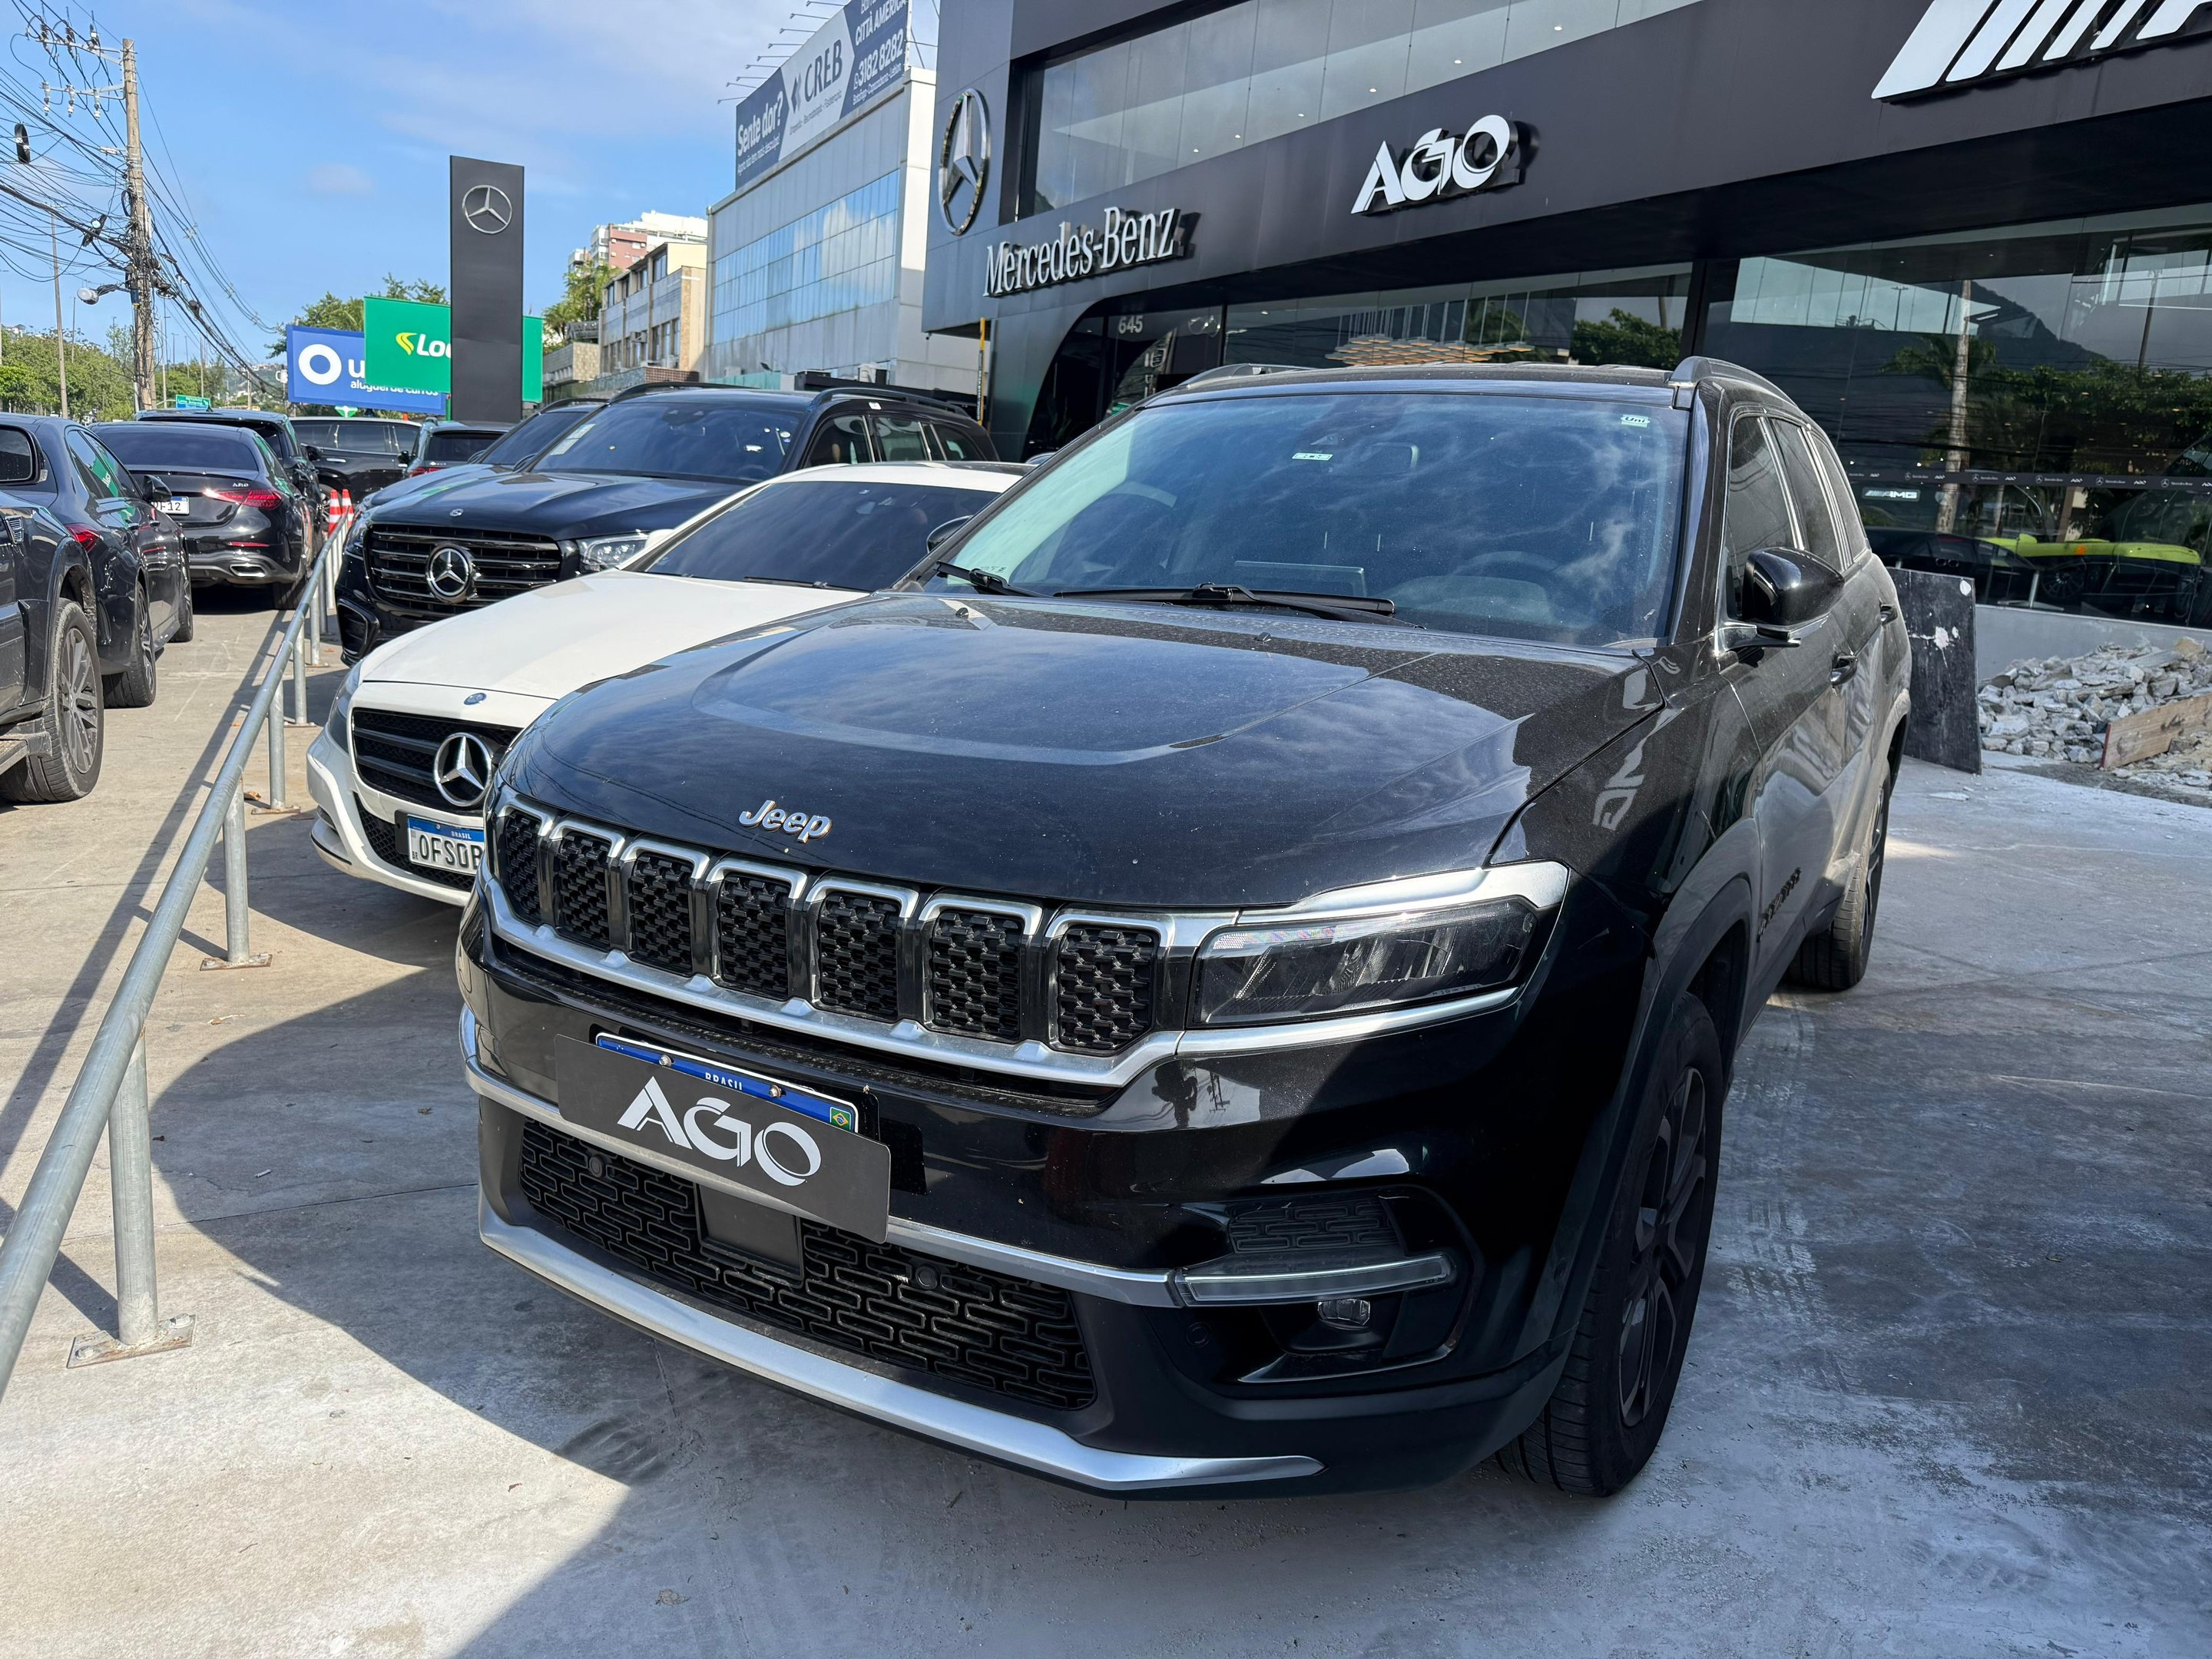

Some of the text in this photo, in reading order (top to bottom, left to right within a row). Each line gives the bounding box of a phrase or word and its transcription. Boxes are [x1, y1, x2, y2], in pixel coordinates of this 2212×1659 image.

[804, 39, 843, 102] CREB
[859, 28, 904, 86] 3182 8282
[738, 114, 761, 157] Sente
[762, 91, 783, 138] dor?
[1350, 114, 1511, 214] AGO
[982, 206, 1176, 297] Mercedes-Benz
[1118, 315, 1144, 334] 645
[451, 830, 472, 839] BRASIL
[739, 800, 833, 843] Jeep
[617, 1075, 822, 1187] AGO
